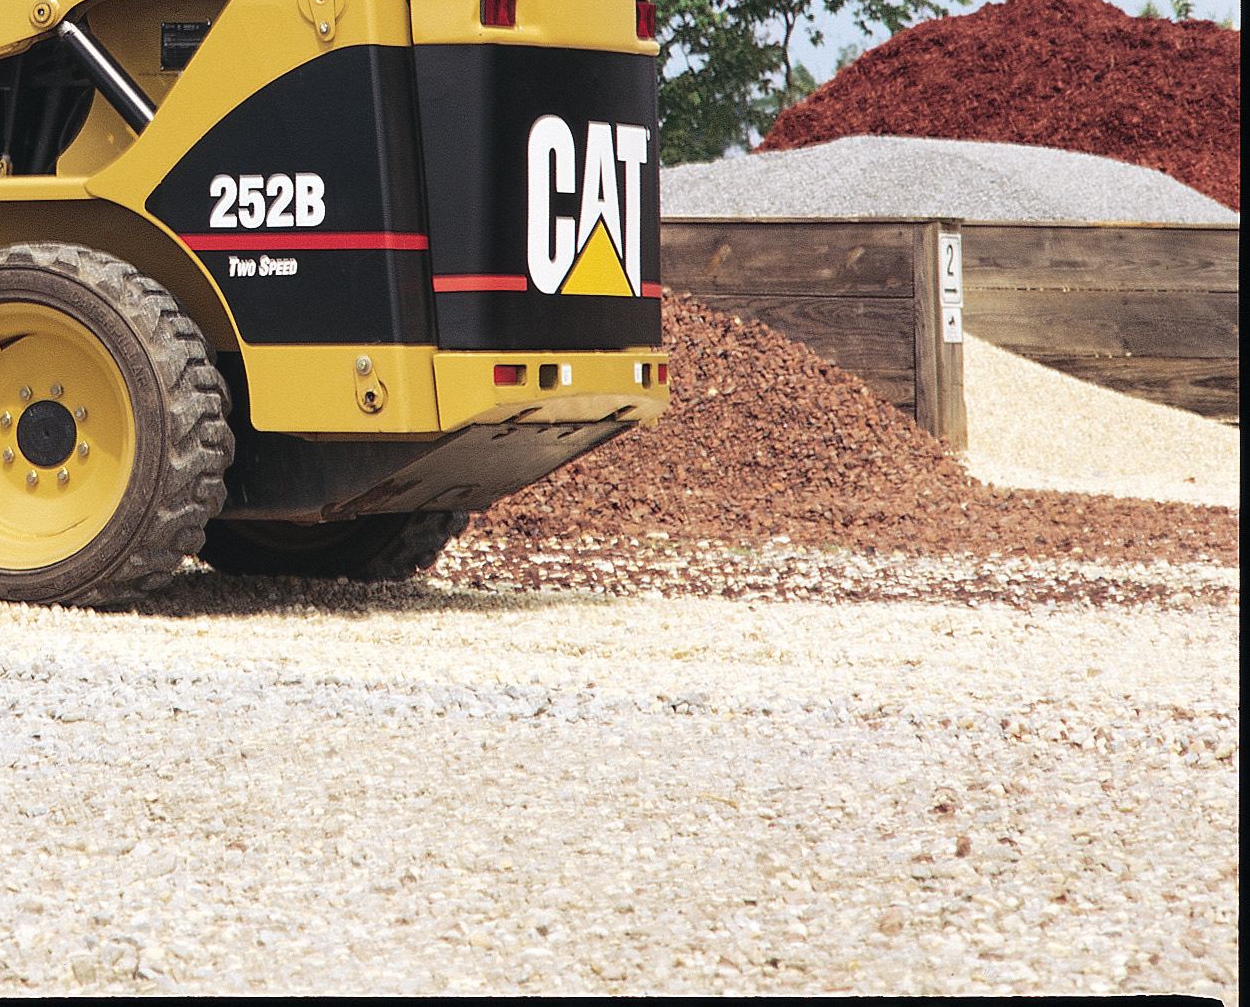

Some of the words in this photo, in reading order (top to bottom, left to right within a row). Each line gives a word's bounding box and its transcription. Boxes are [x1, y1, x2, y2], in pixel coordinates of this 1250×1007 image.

[209, 172, 326, 229] 252B
[527, 114, 648, 298] CAT
[946, 244, 955, 276] 2
